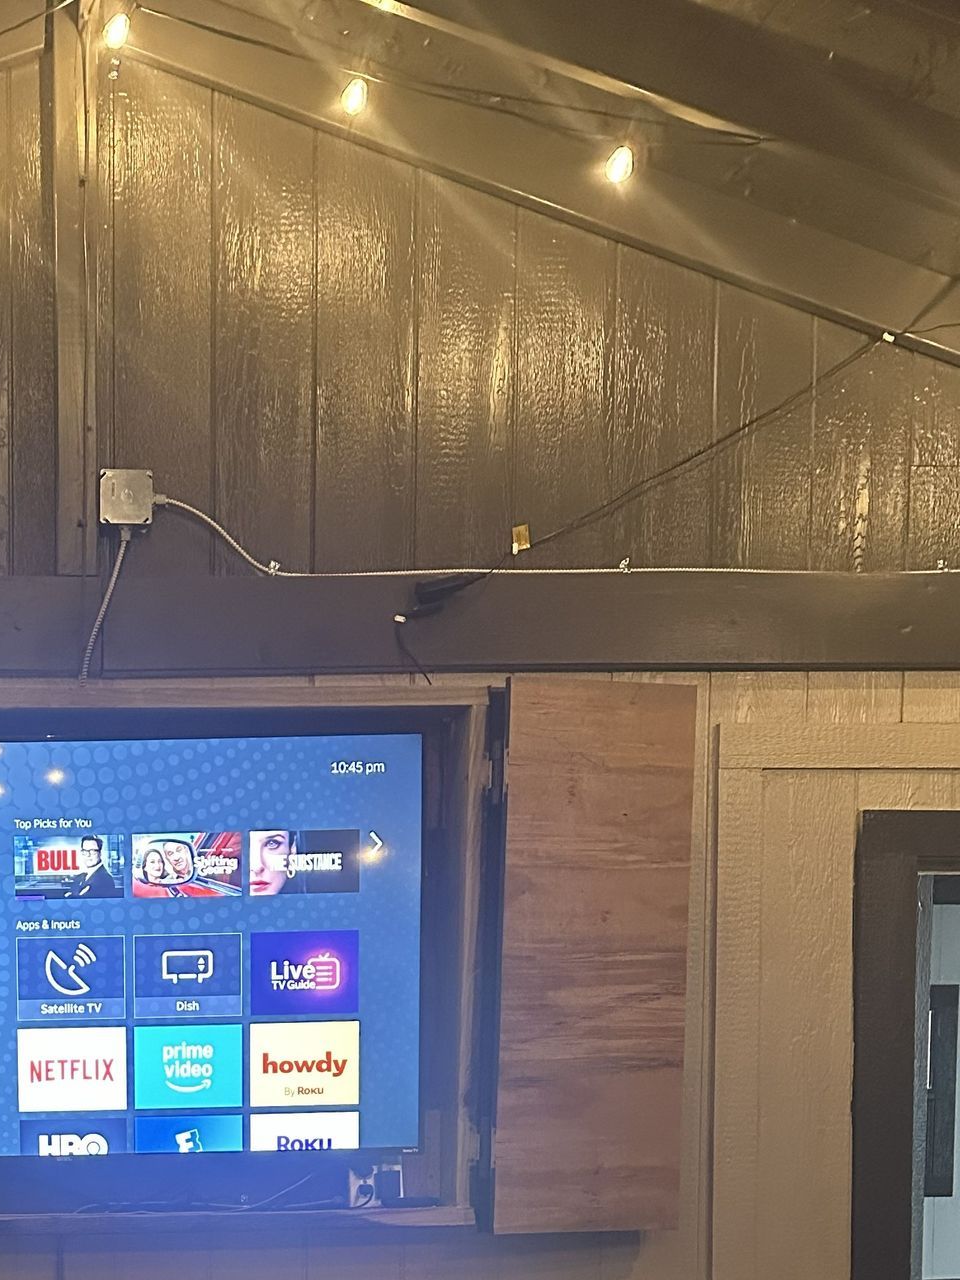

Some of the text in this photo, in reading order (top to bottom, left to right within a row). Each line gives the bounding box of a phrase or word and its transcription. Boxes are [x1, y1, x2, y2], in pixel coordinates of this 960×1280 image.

[330, 761, 385, 776] 10:45 pm
[14, 818, 92, 830] Top Picks for You
[37, 849, 80, 872] BULL
[193, 855, 238, 870] Shifting
[16, 919, 80, 932] Apps & Inputs
[270, 960, 316, 981] Live
[271, 980, 317, 991] TV Guide
[40, 1002, 102, 1015] Satellite TV
[176, 1000, 200, 1012] Dish
[162, 1041, 214, 1062] prime
[29, 1058, 115, 1083] NETFLIX
[164, 1060, 213, 1079] video
[262, 1051, 348, 1078] howdy
[284, 1086, 324, 1098] By Roku
[276, 1135, 332, 1152] Roku
